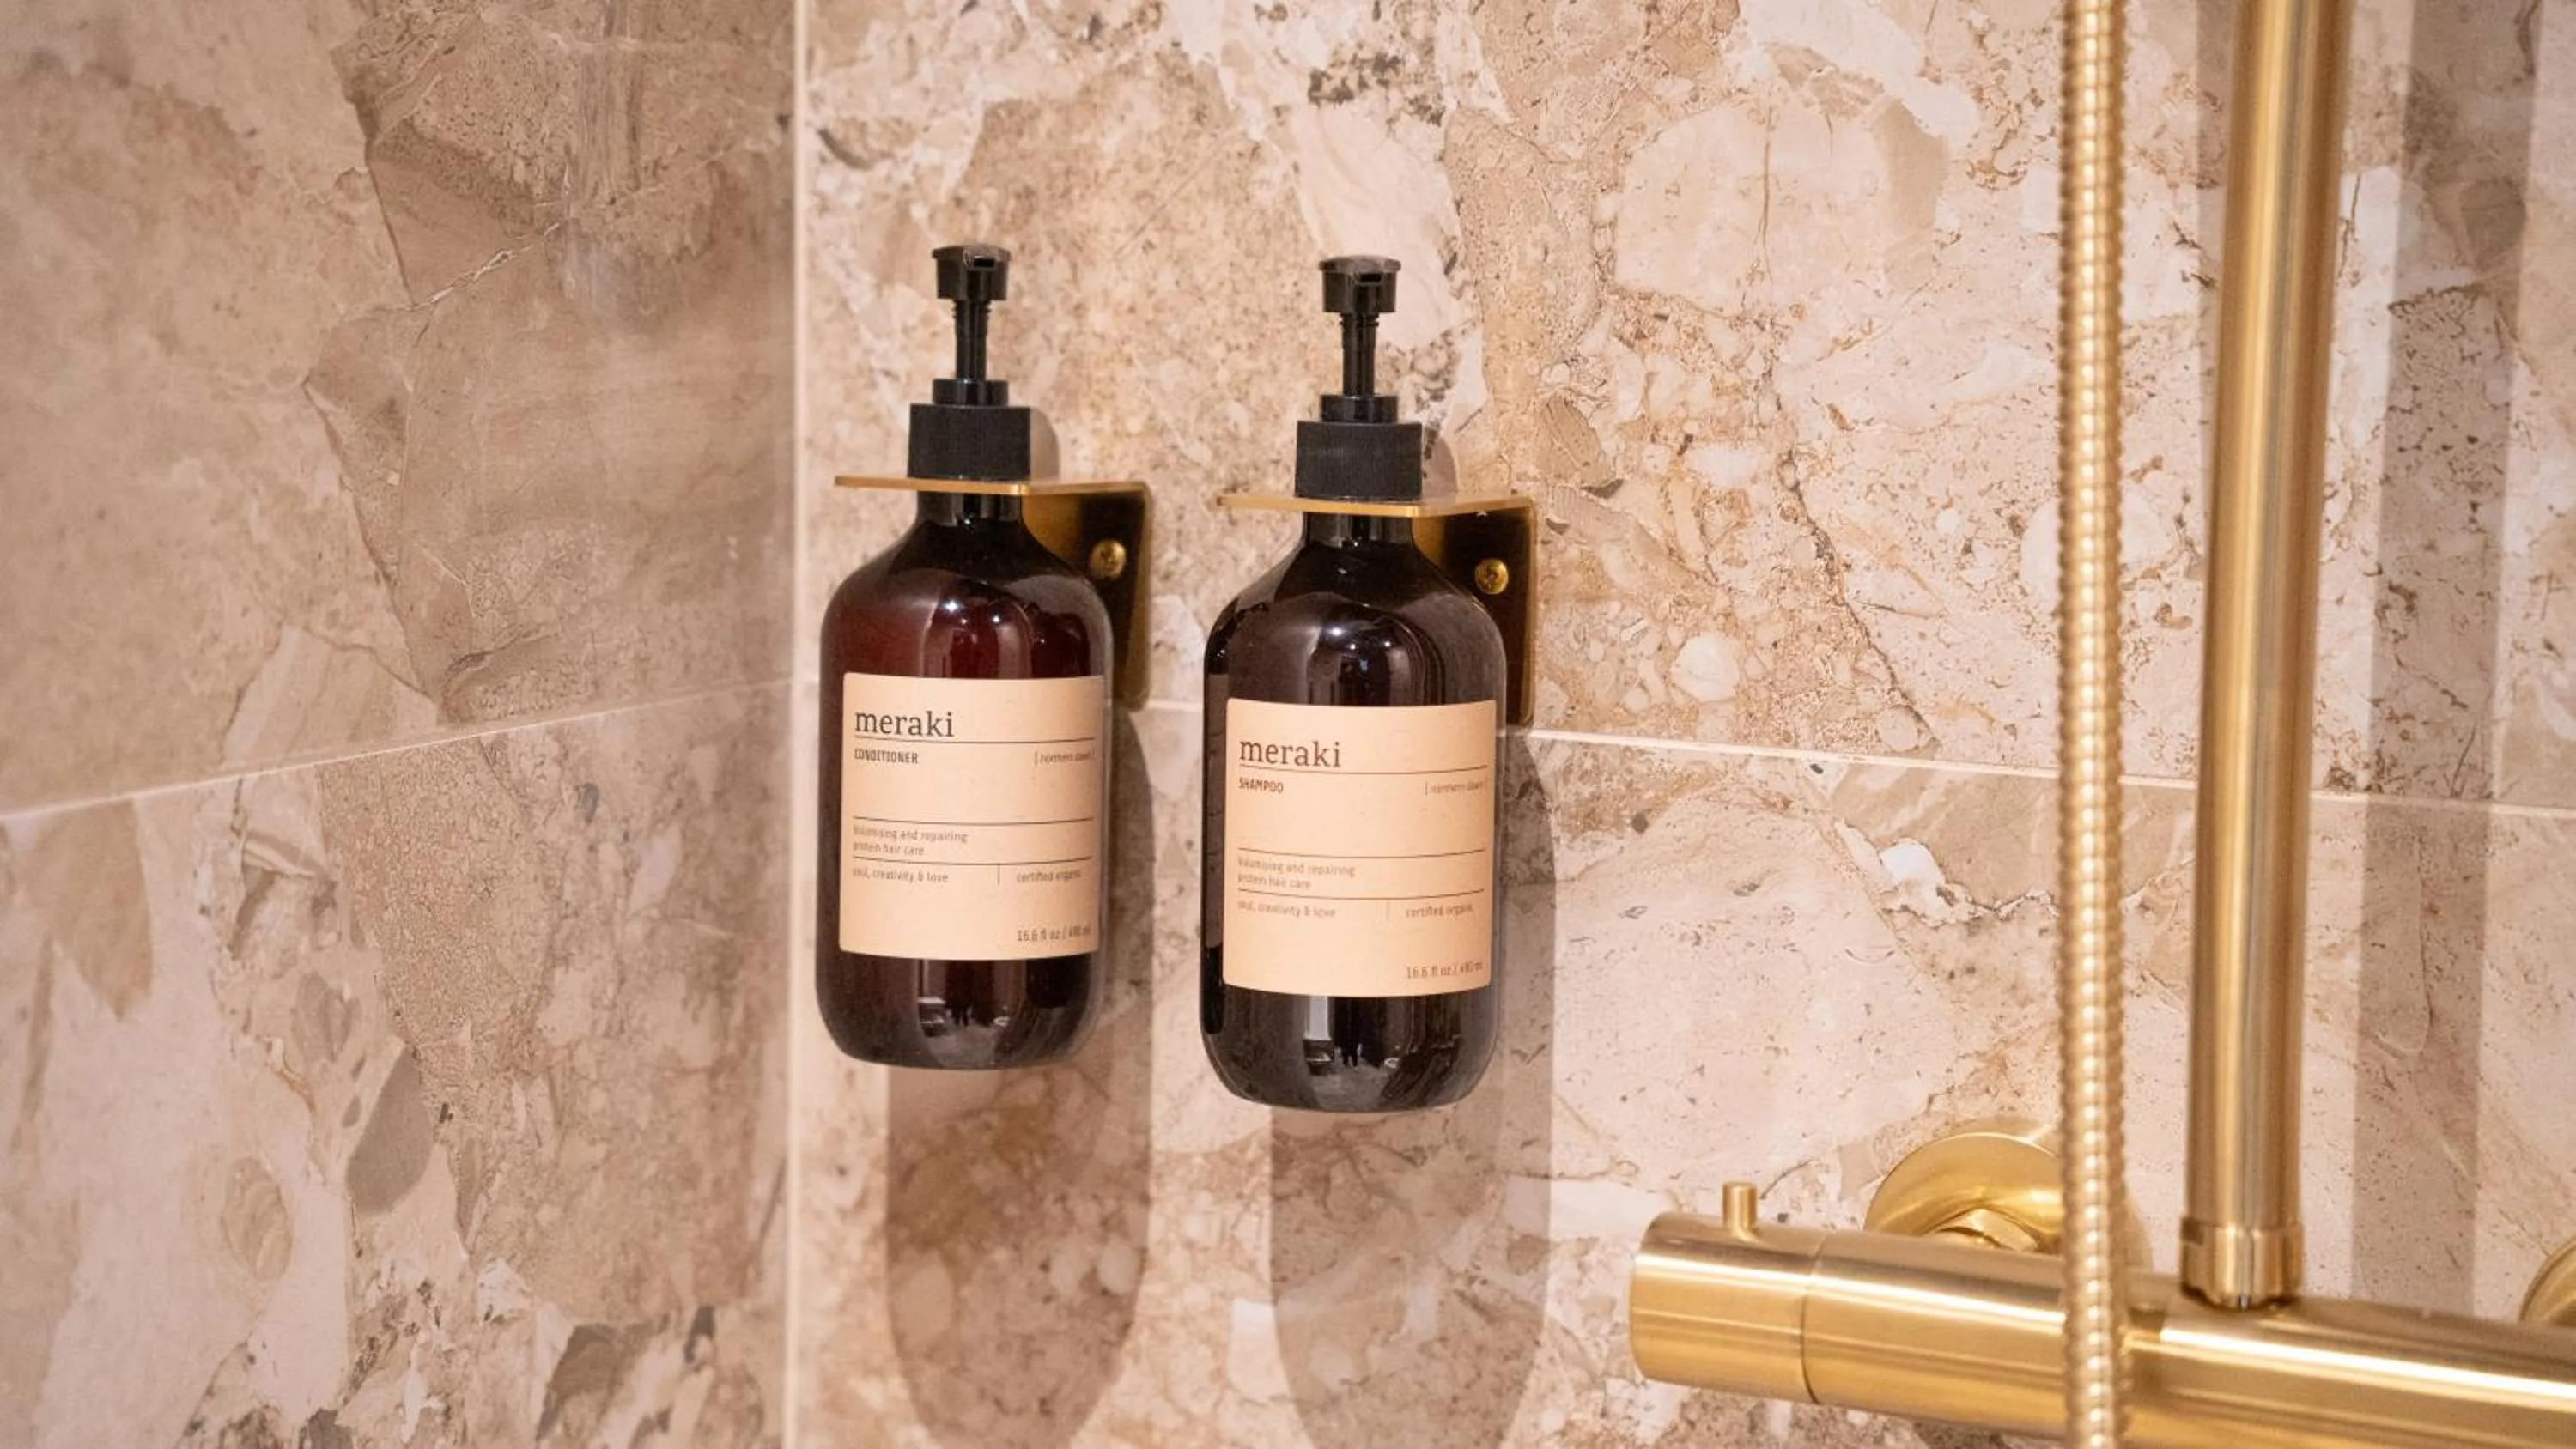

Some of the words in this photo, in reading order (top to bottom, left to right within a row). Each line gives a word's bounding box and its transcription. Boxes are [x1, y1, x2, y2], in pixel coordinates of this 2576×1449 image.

[854, 710, 955, 737] meraki
[854, 748, 919, 764] CONDITIONER
[1239, 739, 1341, 768] meraki
[1238, 777, 1284, 794] SHAMPOO
[900, 829, 918, 840] and
[921, 830, 969, 844] repairing
[903, 846, 925, 856] care
[872, 869, 914, 883] creativity
[927, 870, 949, 883] love
[1016, 871, 1054, 883] certified
[1285, 863, 1304, 873] and
[1308, 864, 1356, 877] repairing
[1290, 879, 1311, 889] care
[1258, 902, 1301, 918] creativity
[1313, 906, 1335, 918] love
[1406, 905, 1443, 918] certified
